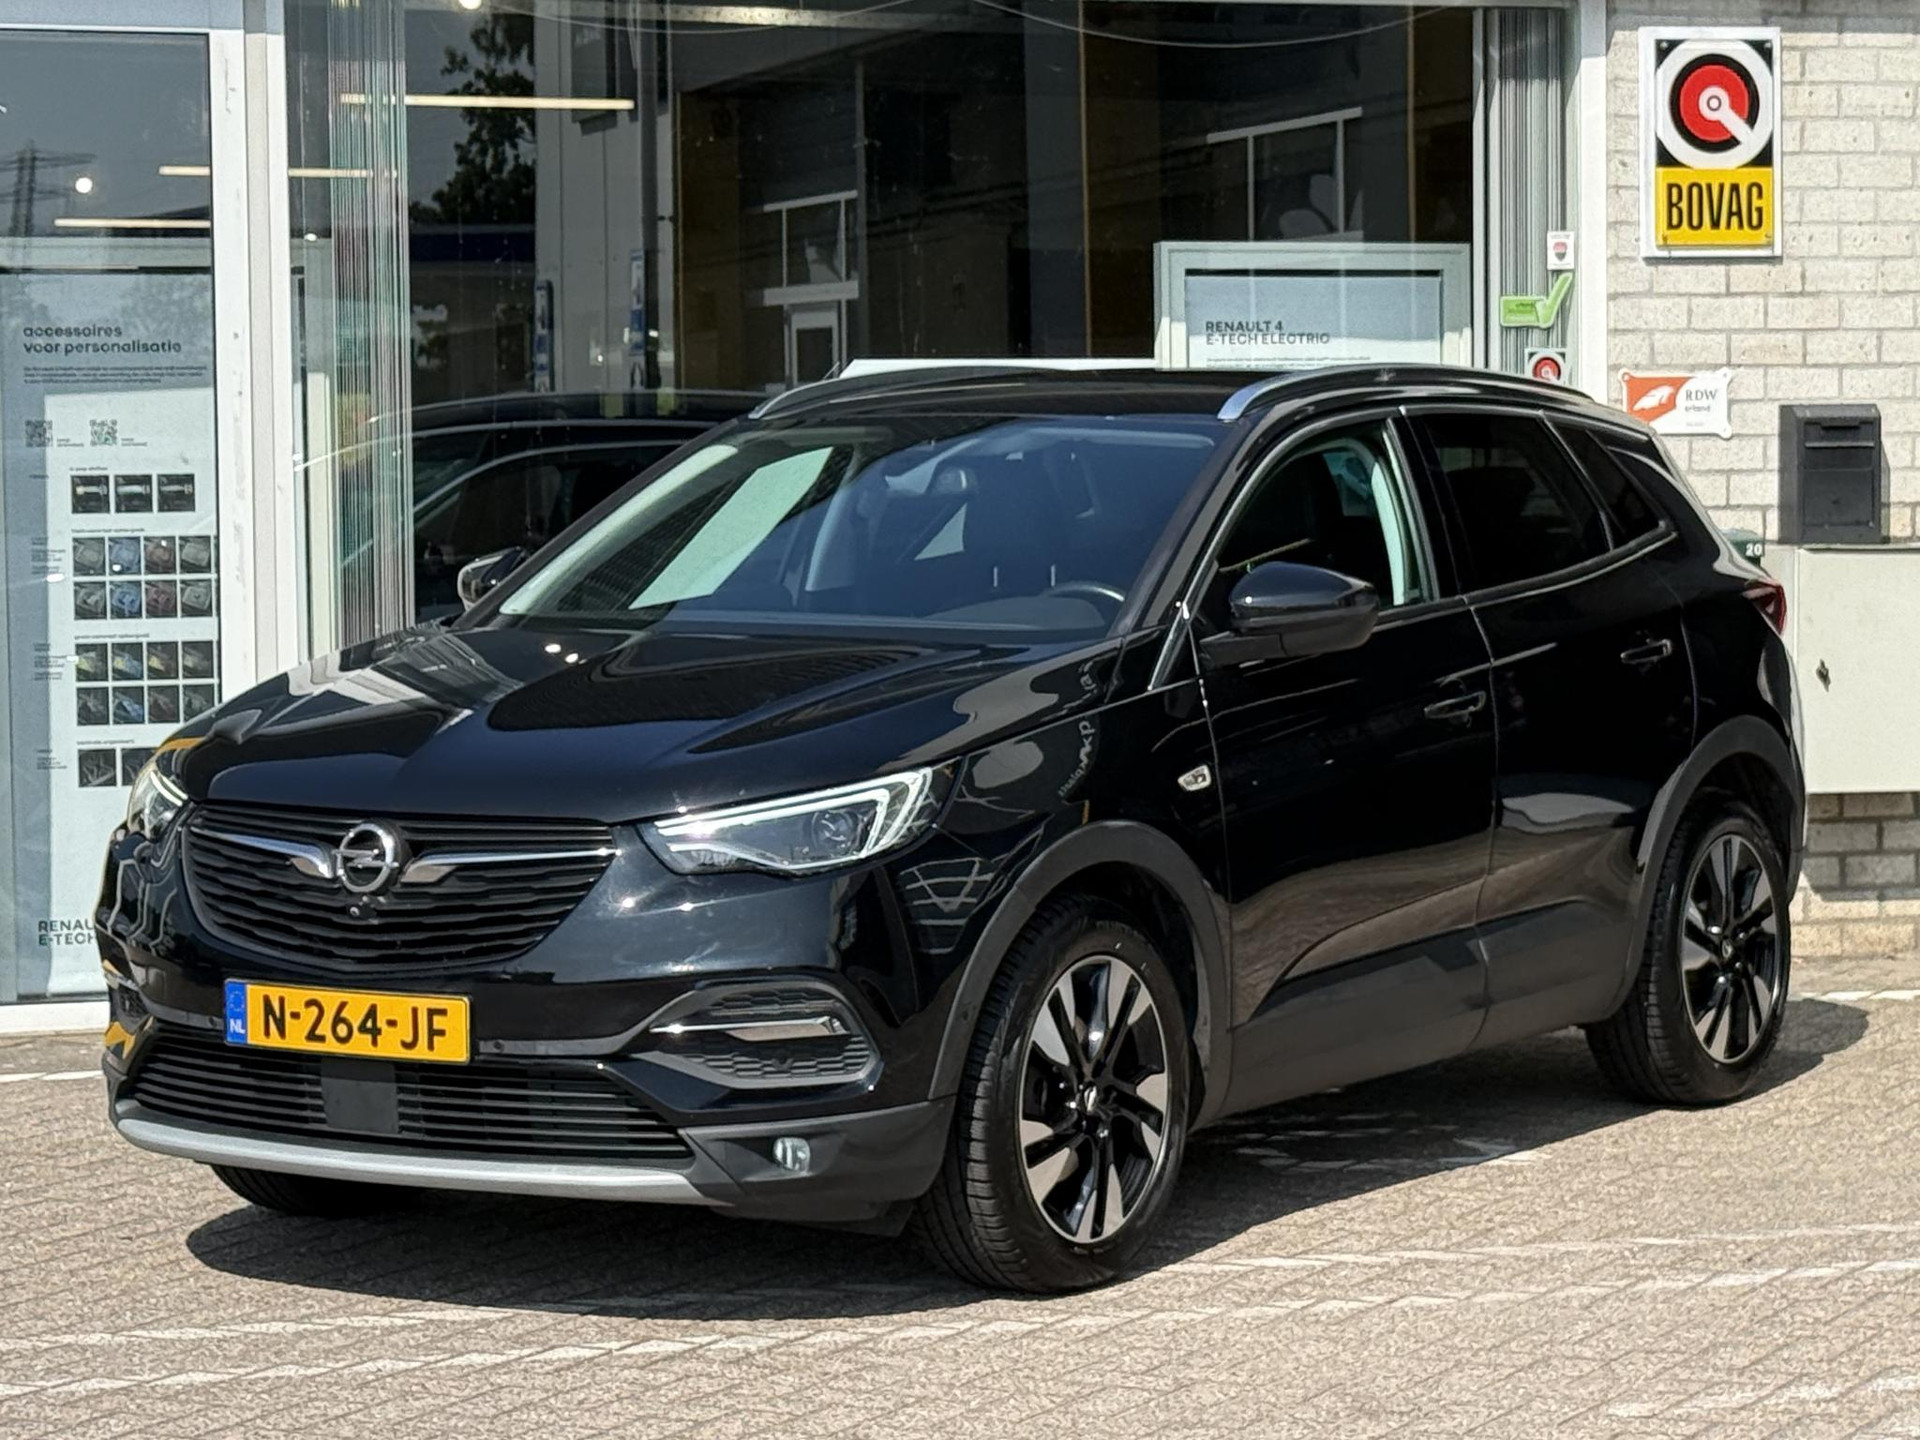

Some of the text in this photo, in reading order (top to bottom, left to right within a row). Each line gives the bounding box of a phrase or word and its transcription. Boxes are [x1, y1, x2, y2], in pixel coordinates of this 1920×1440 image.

[1665, 182, 1764, 231] BOVAG
[23, 325, 123, 338] accessoires
[1205, 320, 1284, 333] RENAULT 4
[1206, 332, 1330, 345] E-TECH ELECTRIC
[23, 339, 182, 356] voor personalisatie
[1685, 389, 1718, 401] RDW
[1745, 543, 1763, 557] 20
[229, 1018, 246, 1034] NL
[262, 994, 448, 1051] N-264-JF
